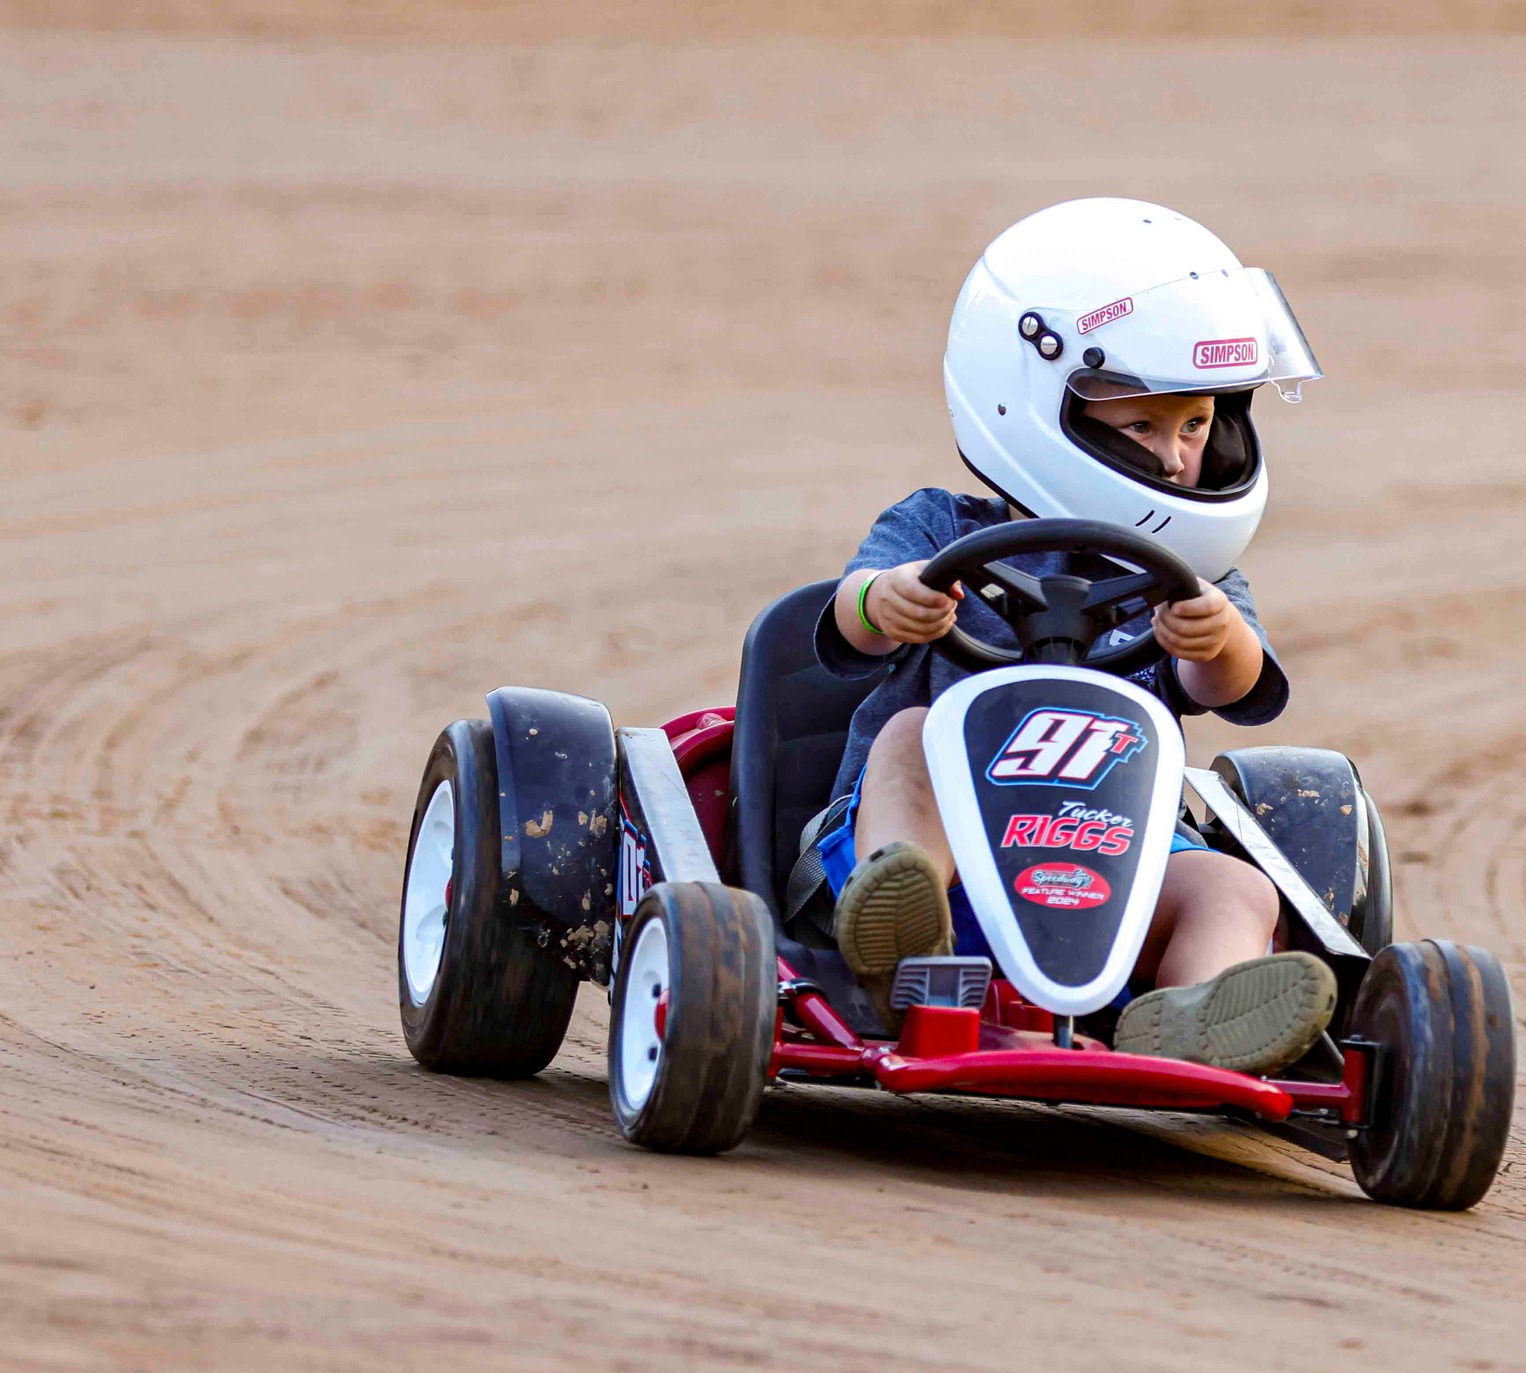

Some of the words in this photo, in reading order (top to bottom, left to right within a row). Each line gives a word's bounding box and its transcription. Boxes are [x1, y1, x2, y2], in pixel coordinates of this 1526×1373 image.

[1081, 302, 1128, 331] SIMPSON
[1200, 344, 1255, 364] SIMPSON
[1060, 801, 1133, 827] Tucker
[1001, 814, 1135, 855] RIGGS
[1032, 870, 1084, 889] Speedway
[1022, 887, 1065, 896] FEATURE
[1068, 890, 1104, 900] WINNER
[1046, 896, 1080, 905] 2024
